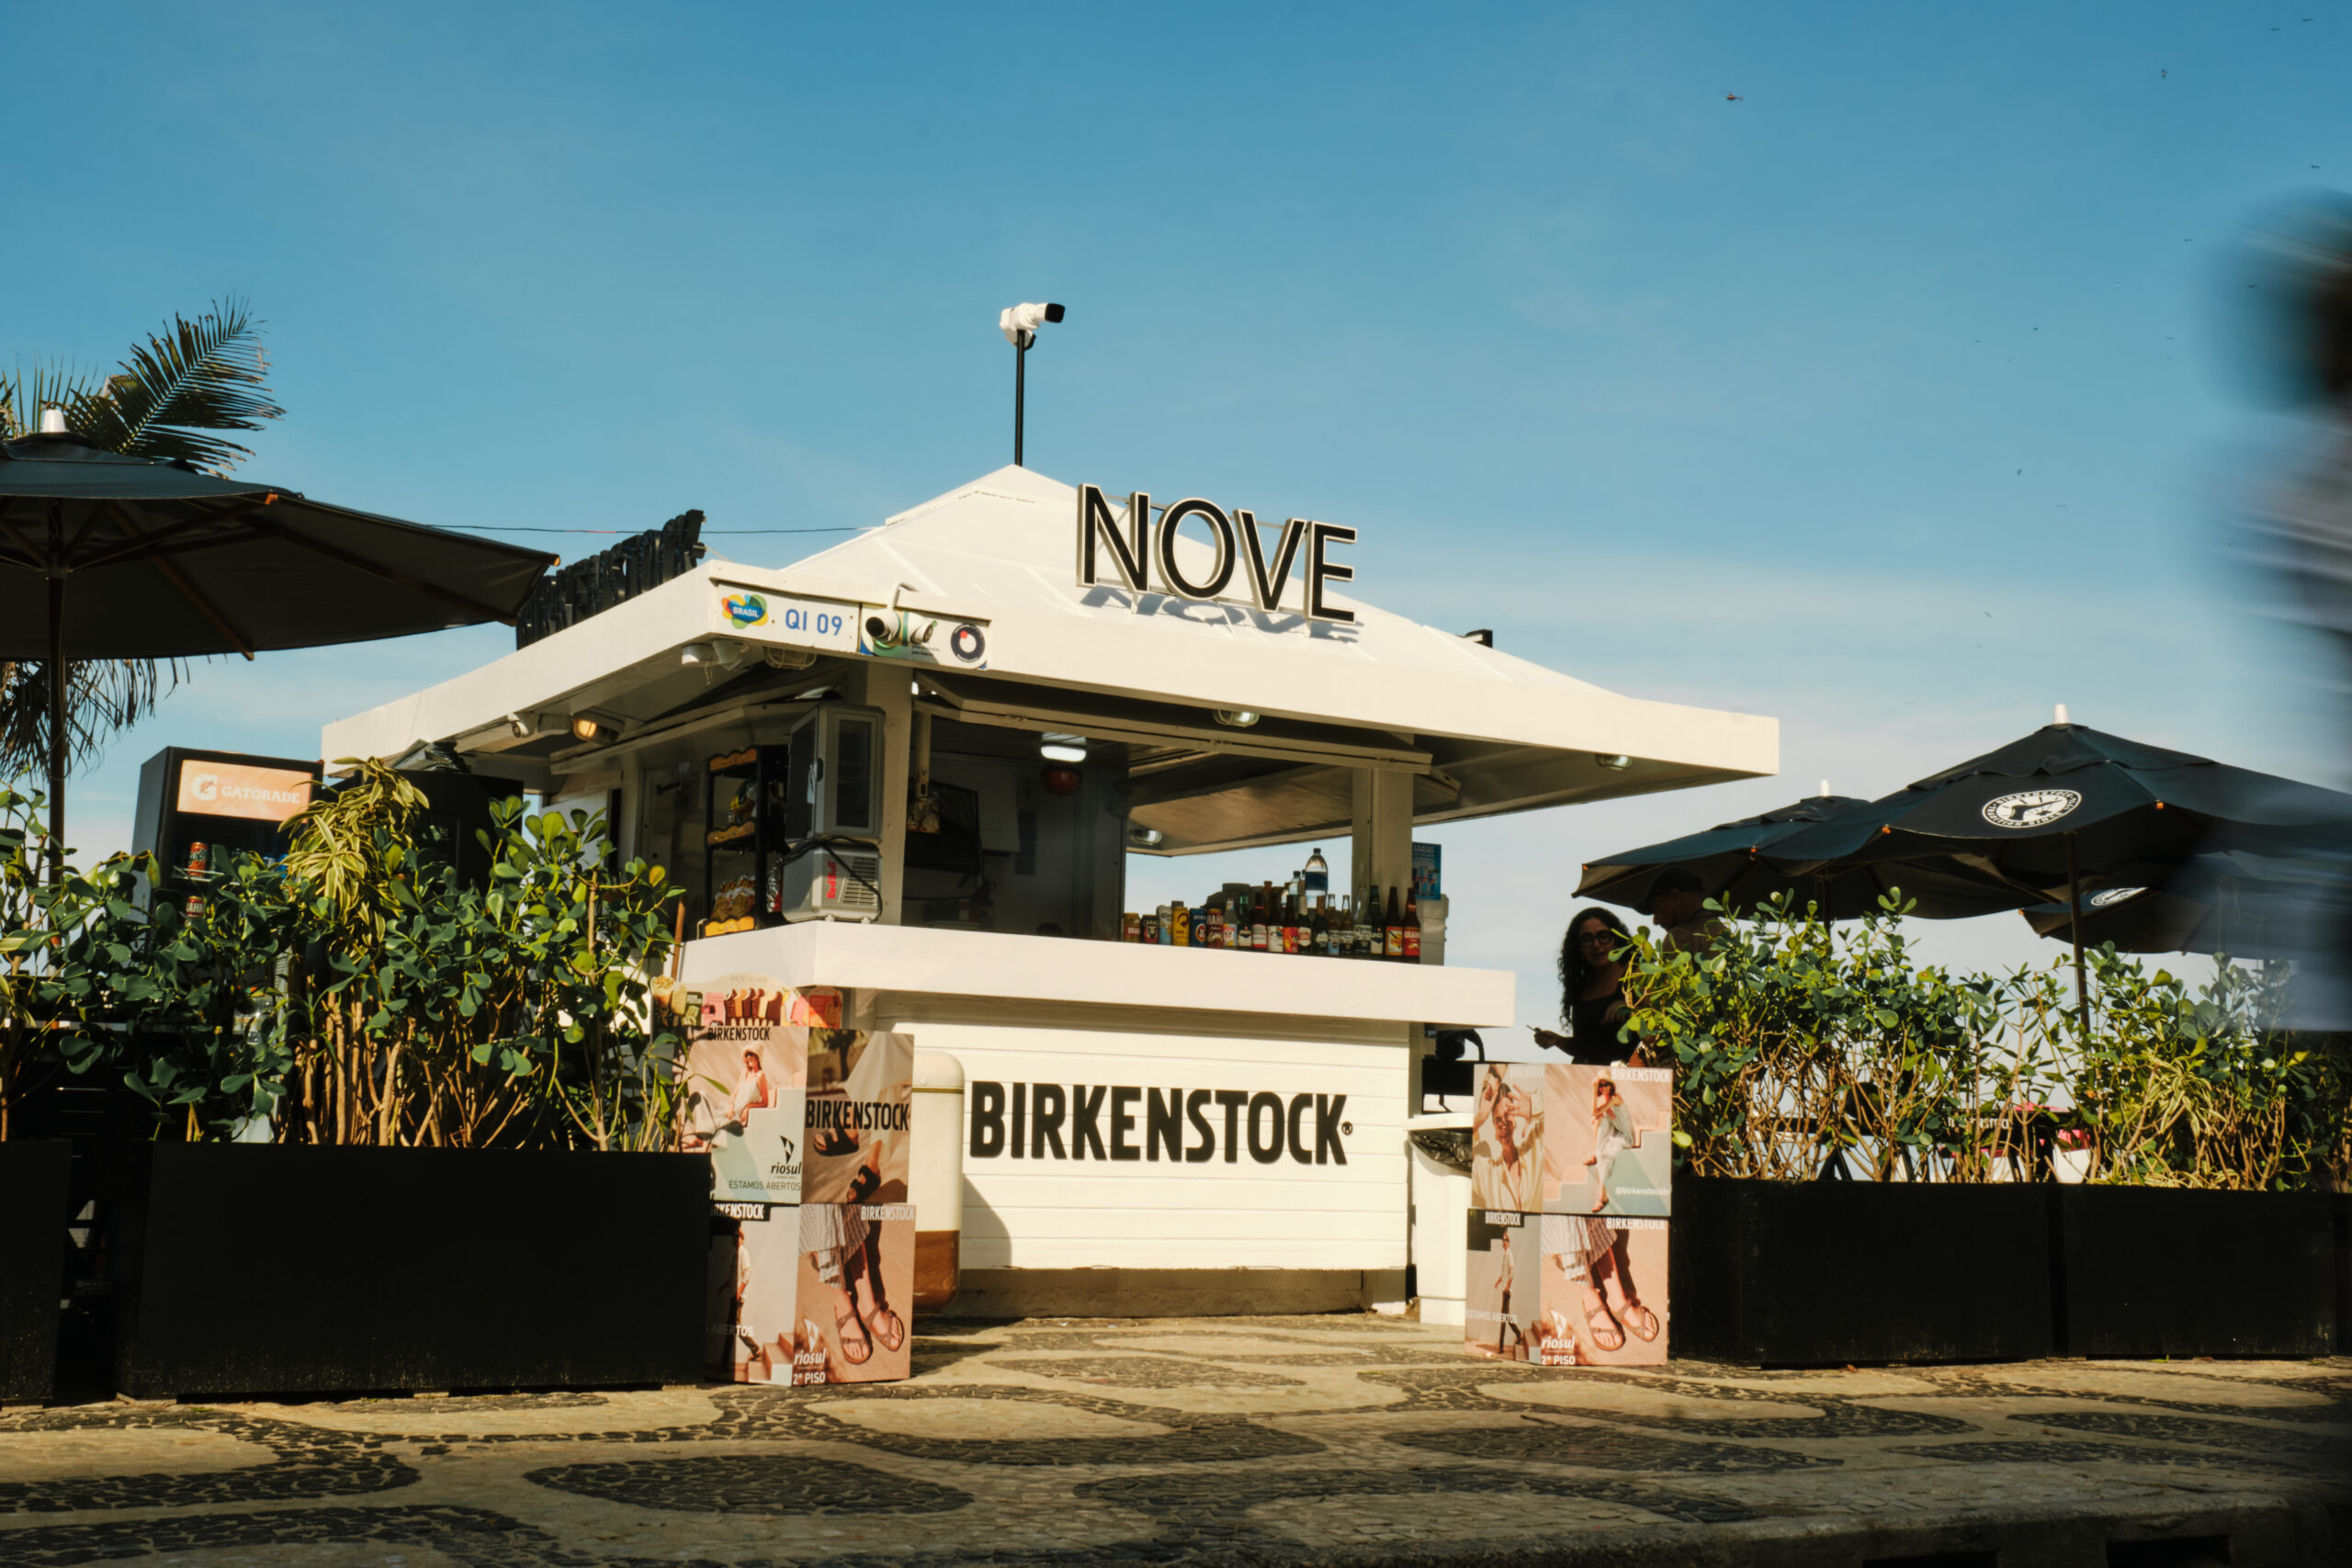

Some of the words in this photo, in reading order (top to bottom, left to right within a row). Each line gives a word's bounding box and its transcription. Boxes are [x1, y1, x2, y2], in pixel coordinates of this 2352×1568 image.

[1076, 483, 1357, 625] NOVE
[733, 606, 760, 617] BRASIL
[817, 614, 842, 636] 09
[220, 785, 300, 804] GATORADE
[827, 860, 837, 879] Bull
[826, 880, 837, 898] Red
[707, 1027, 770, 1041] BIRKENSTOCK
[1611, 1067, 1670, 1082] BIRKENSTOCK
[806, 1100, 909, 1131] BIRKENSTOCK
[771, 1161, 802, 1175] riosul
[729, 1179, 763, 1190] ESTAMOS
[766, 1181, 801, 1191] ABERTOS
[861, 1205, 914, 1221] BIRKENSTOCK
[1485, 1211, 1521, 1225] BIRKENSTOCK
[1606, 1217, 1666, 1230] BIRKENSTOCK
[1542, 1335, 1576, 1349] riosul
[794, 1348, 826, 1365] riosul
[1554, 1355, 1576, 1366] PISO
[805, 1371, 826, 1383] PISO
